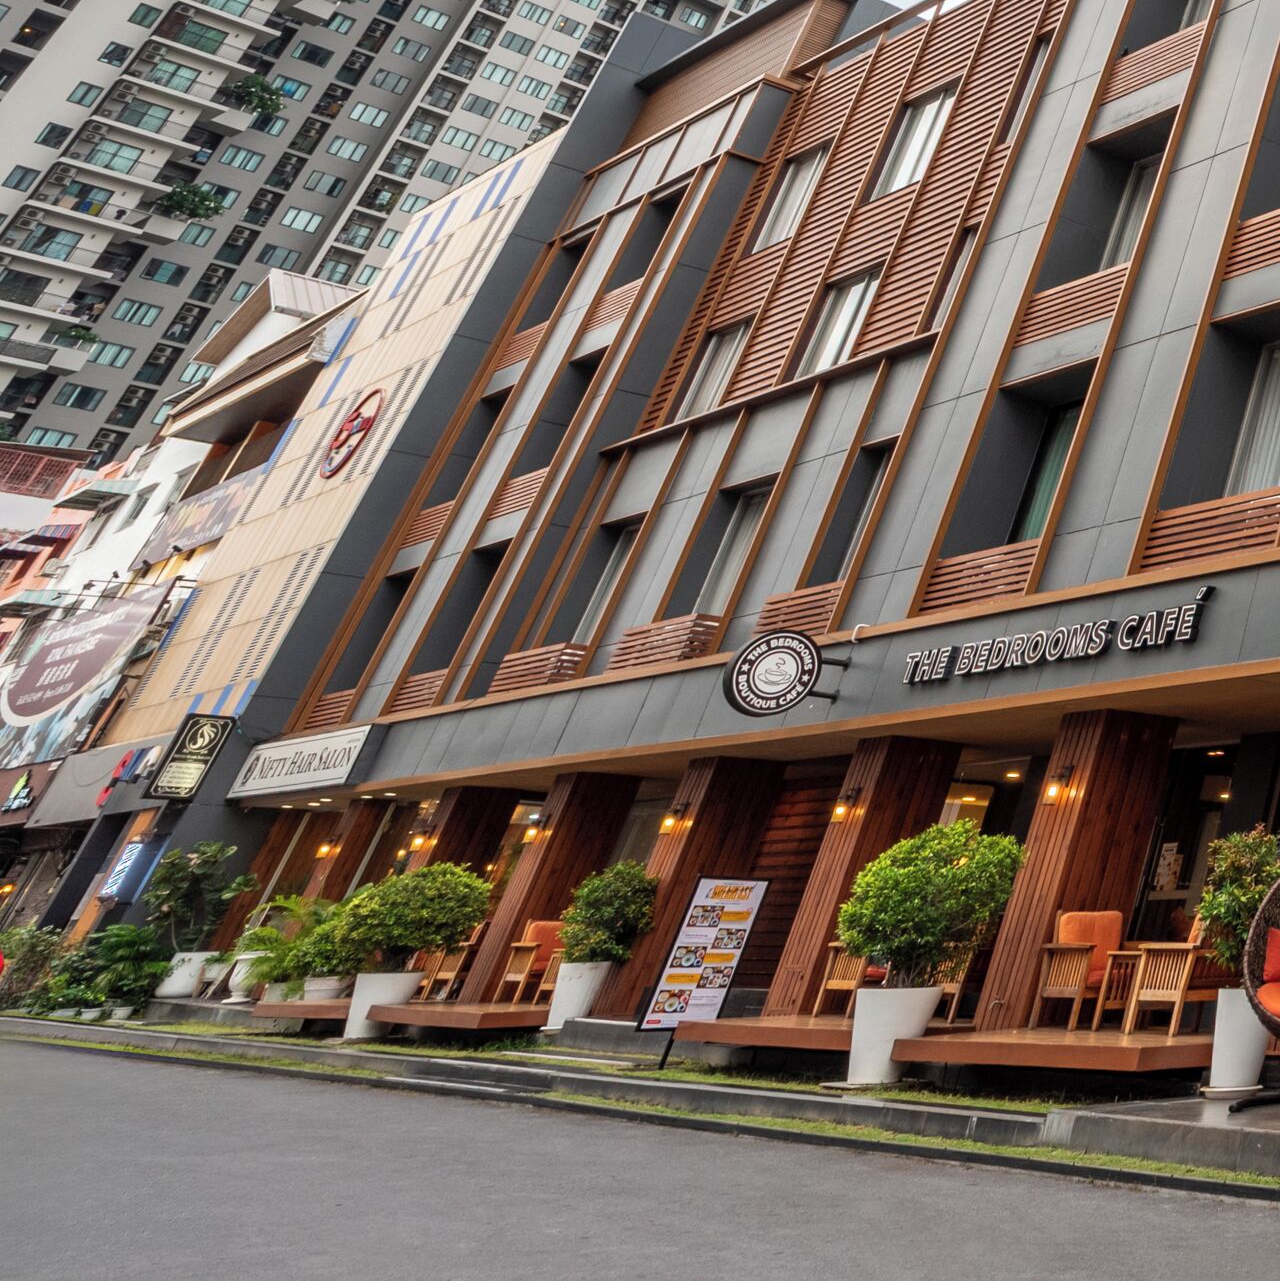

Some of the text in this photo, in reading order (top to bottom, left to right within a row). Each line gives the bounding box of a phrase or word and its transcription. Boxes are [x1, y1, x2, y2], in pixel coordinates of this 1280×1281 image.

[746, 638, 814, 670] THE BEDROOMS
[903, 646, 956, 685] THE
[954, 619, 1114, 676] BEDROOMS
[737, 674, 777, 708] BOUTIQUE
[253, 746, 357, 781] NIFTY HAIR SALON
